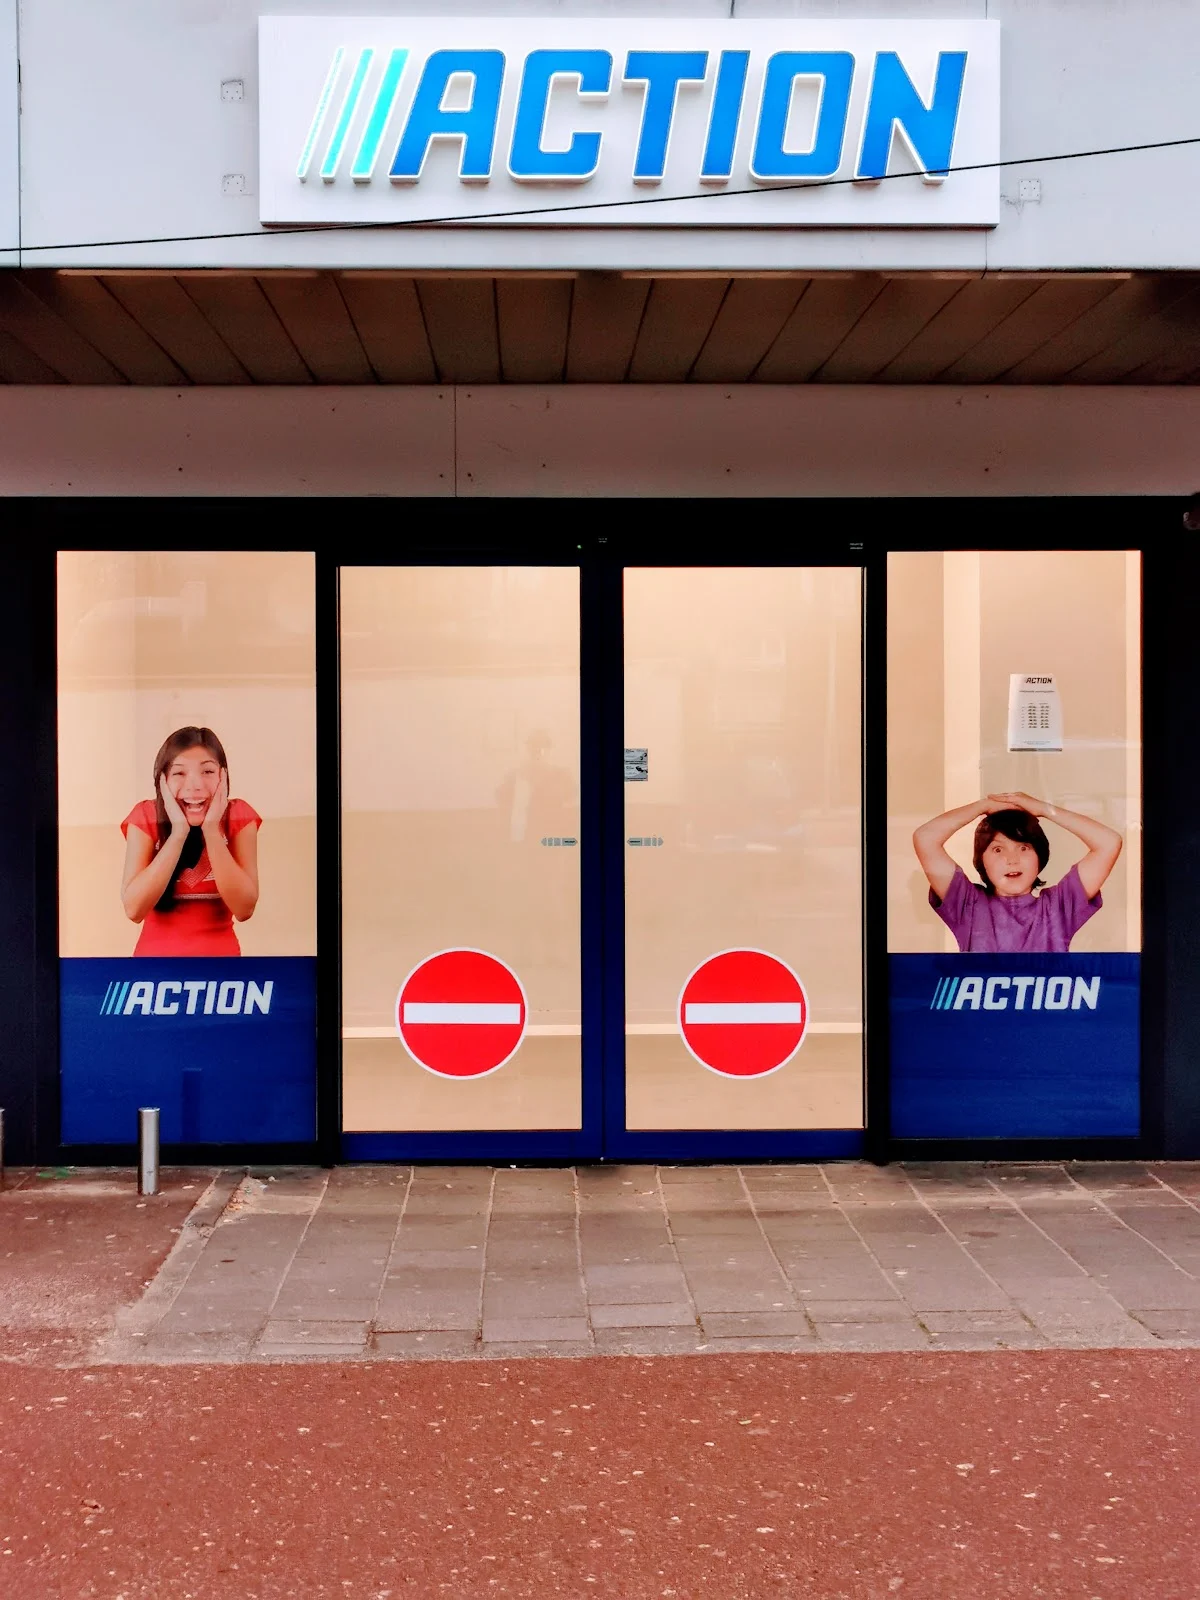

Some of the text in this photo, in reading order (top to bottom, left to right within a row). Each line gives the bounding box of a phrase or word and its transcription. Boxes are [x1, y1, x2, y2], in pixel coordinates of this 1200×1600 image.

[389, 49, 968, 182] ACTION
[123, 981, 273, 1015] ACTION
[952, 976, 1101, 1010] ACTION
